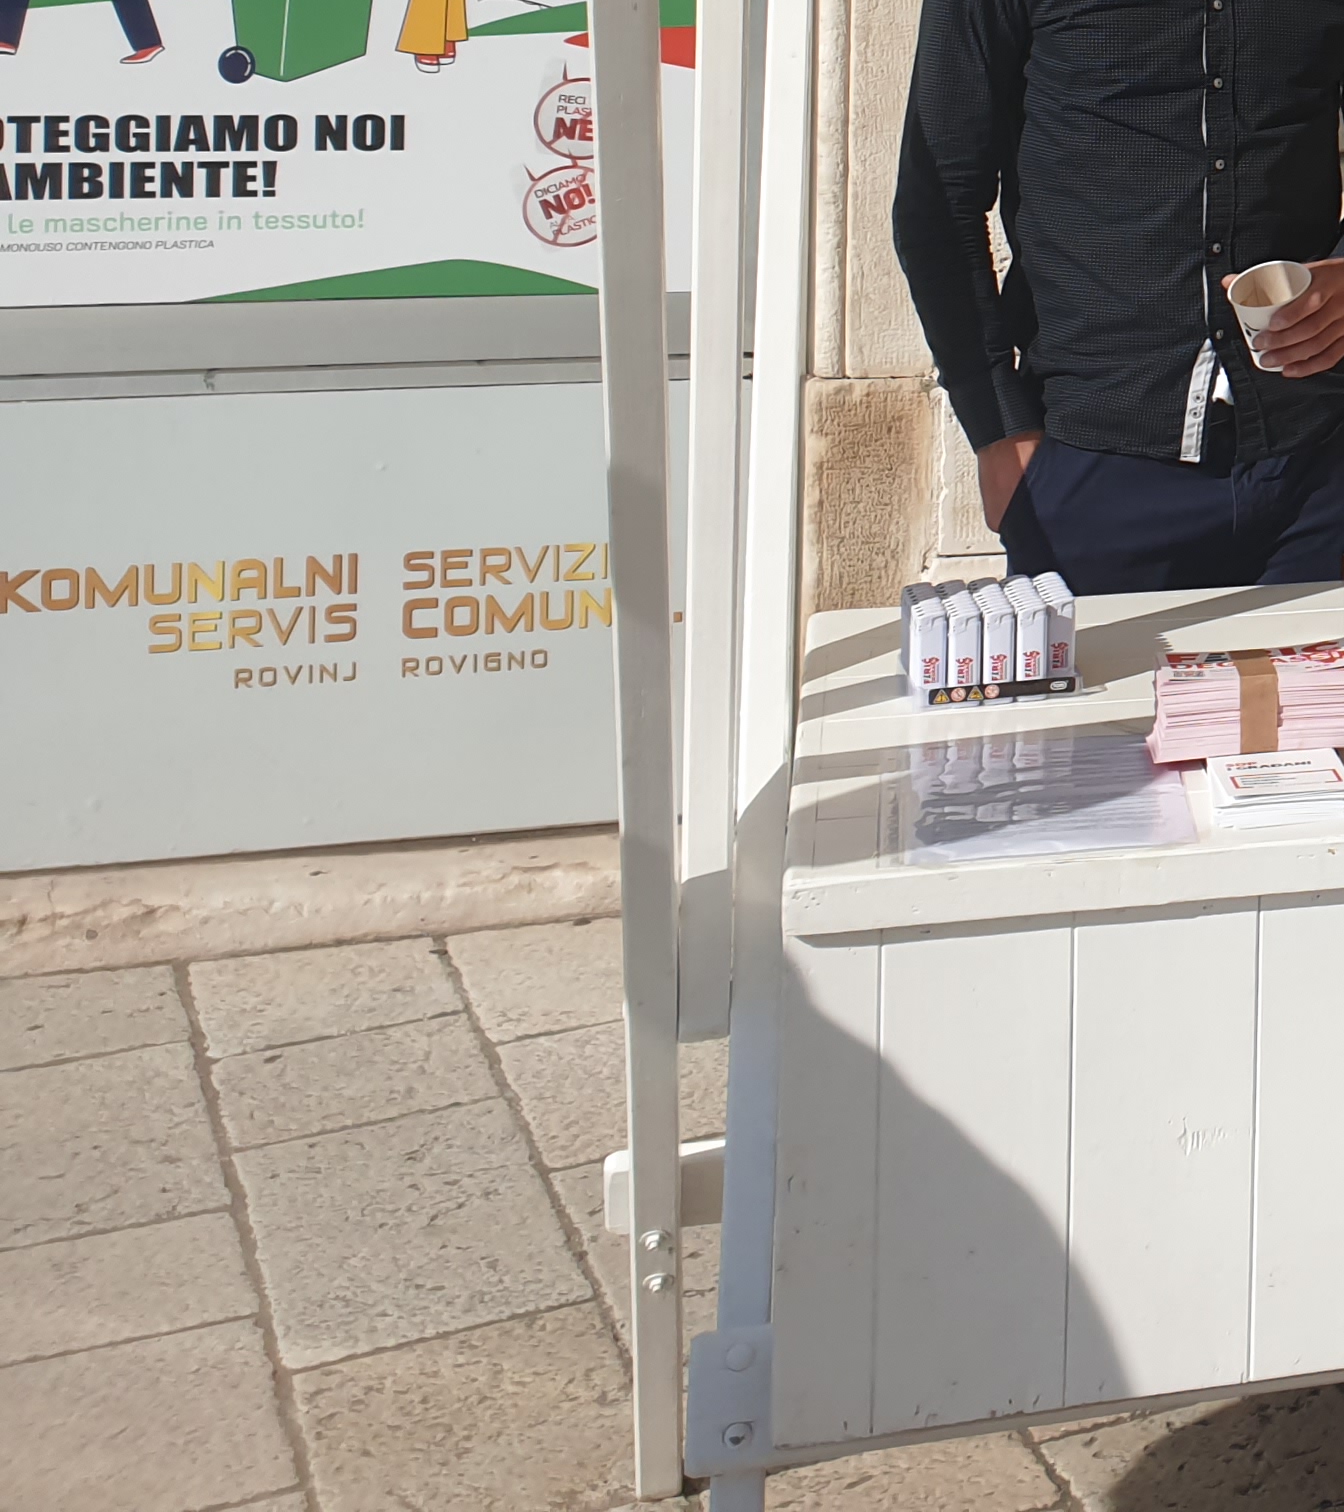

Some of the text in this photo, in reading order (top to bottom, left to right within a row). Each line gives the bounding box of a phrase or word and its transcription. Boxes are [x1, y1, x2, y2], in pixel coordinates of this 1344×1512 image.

[0, 114, 406, 153] TEGGIAMO NOI
[534, 174, 586, 198] DICIAMO
[539, 184, 595, 220] NO!
[8, 208, 365, 234] le mascherine in tessuto!
[66, 241, 152, 252] CONTENGONO
[155, 239, 215, 250] PLASTICA
[0, 553, 358, 614] KOMUNALNI
[403, 542, 608, 590] SERVIZI
[148, 603, 358, 654] SERVIS
[402, 588, 613, 639] COMUN
[234, 662, 358, 689] ROVINJ
[401, 648, 548, 678] ROVIGNO
